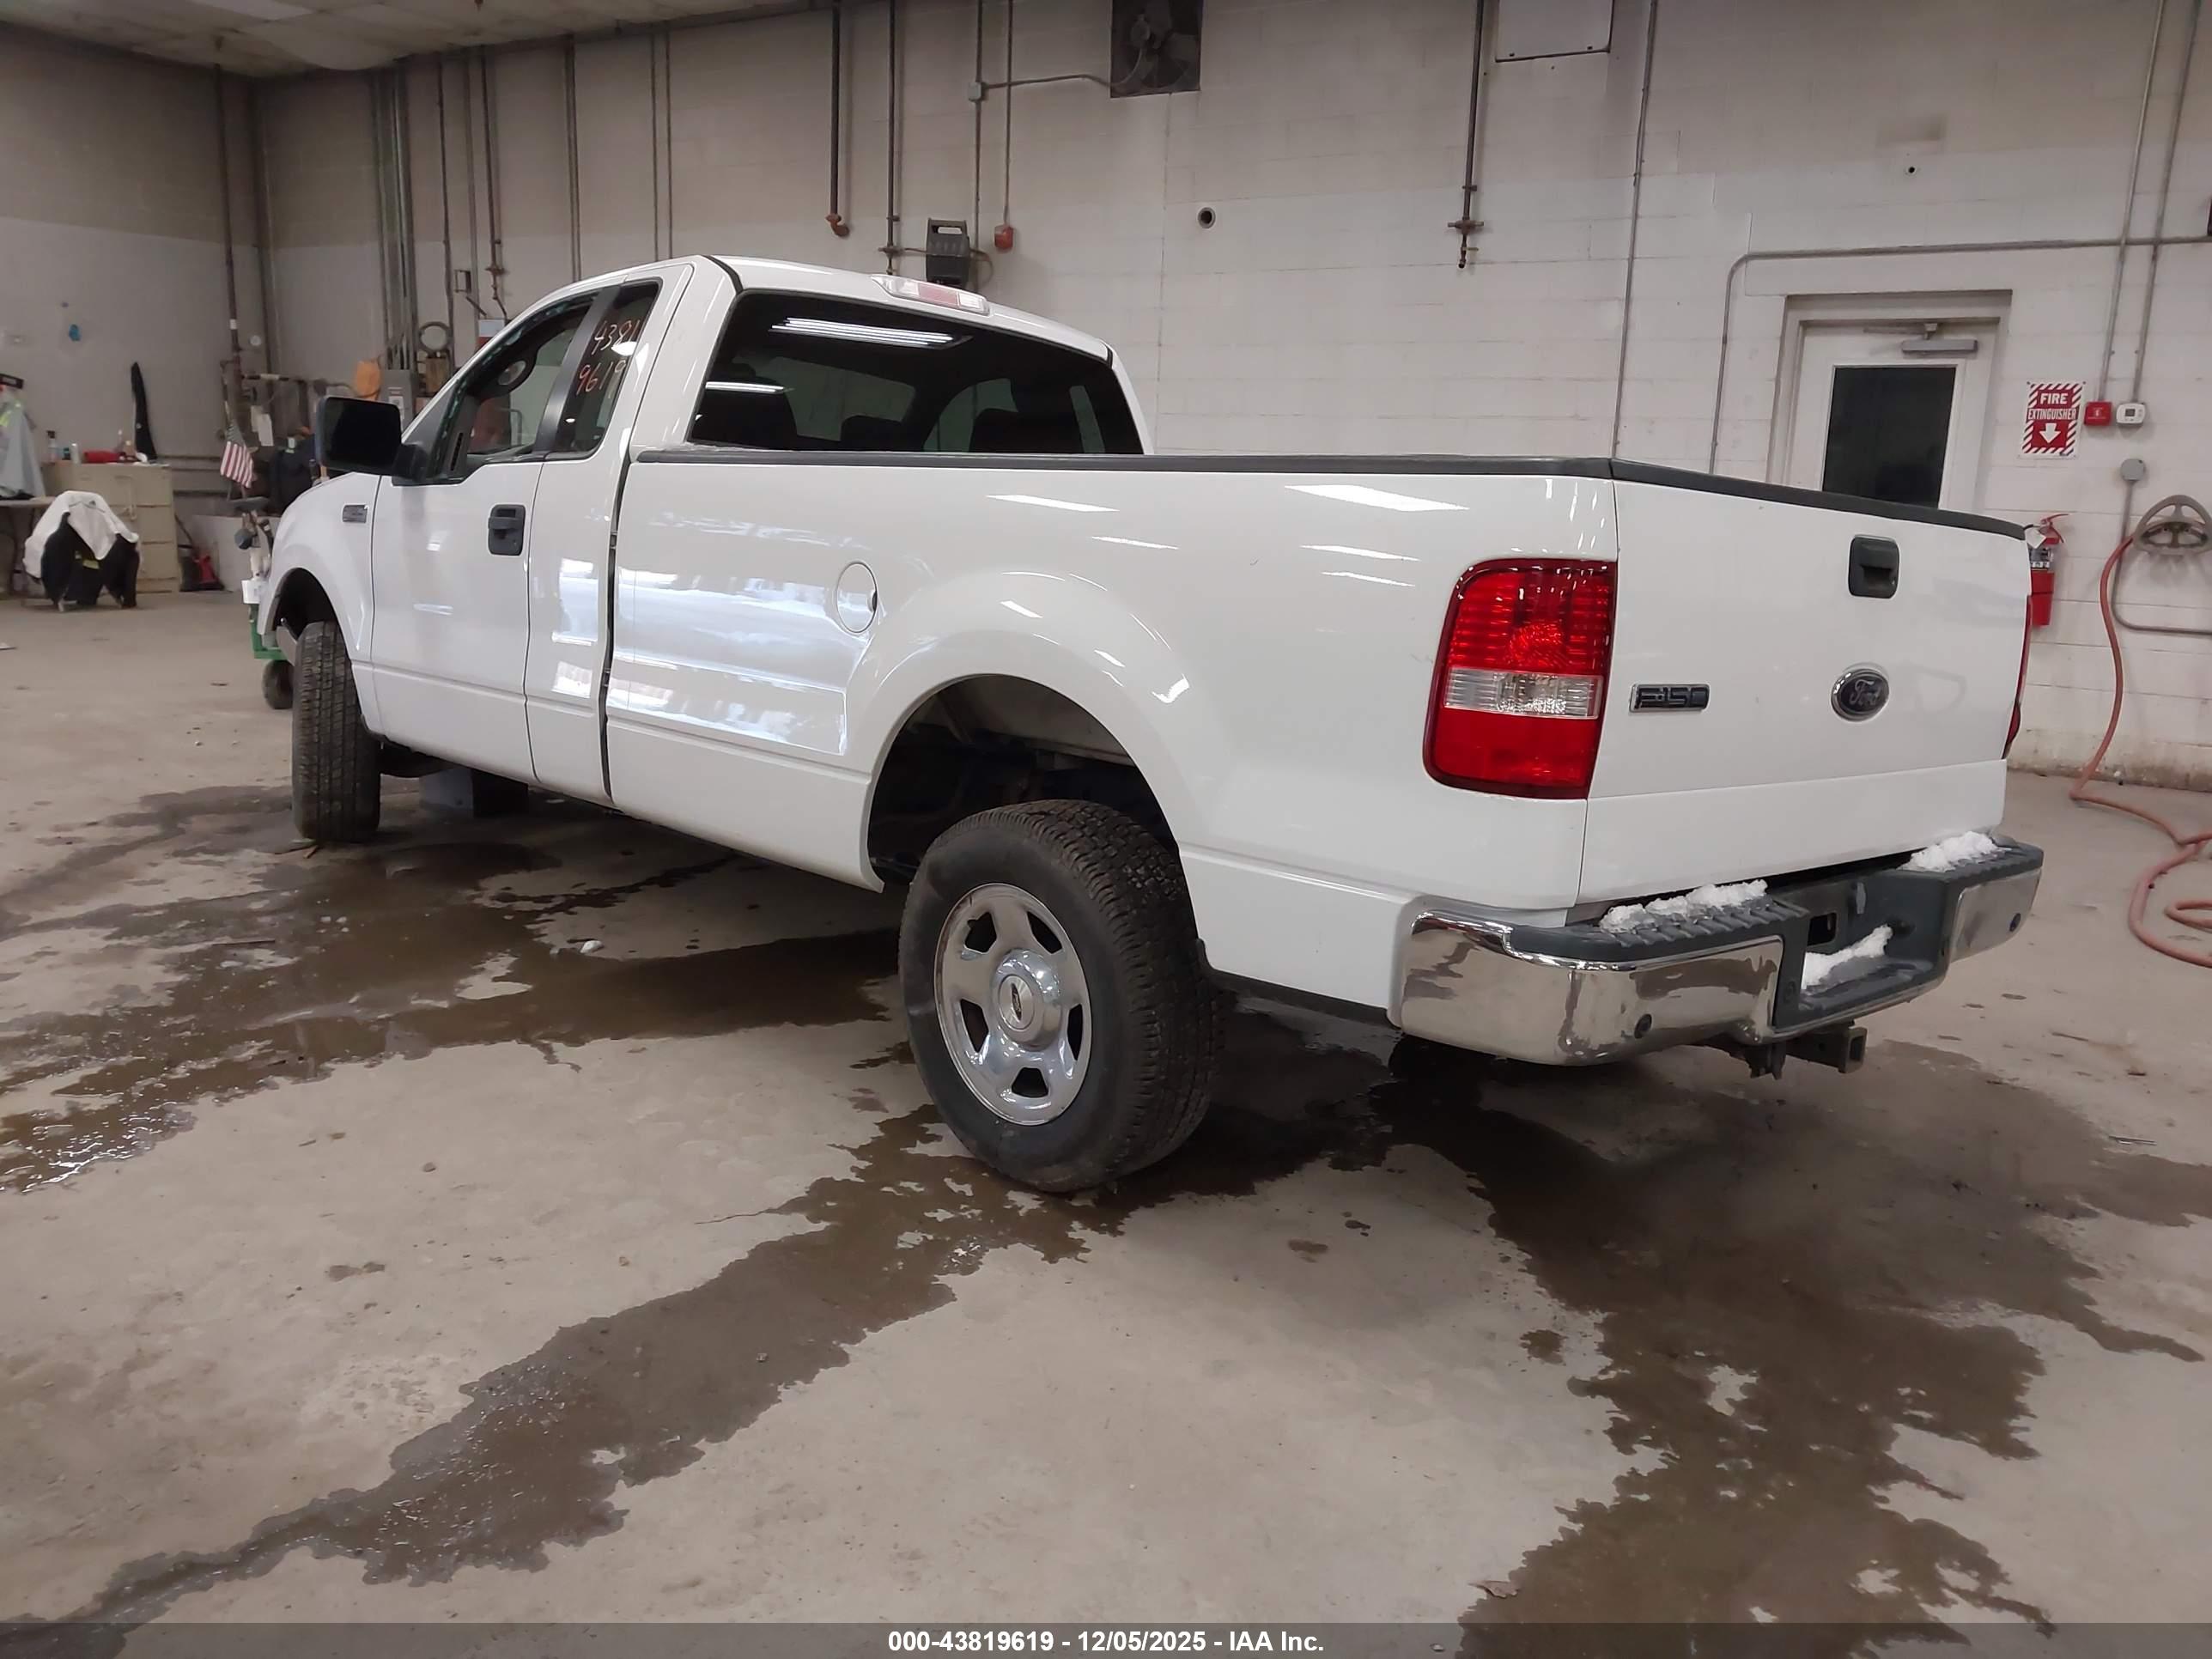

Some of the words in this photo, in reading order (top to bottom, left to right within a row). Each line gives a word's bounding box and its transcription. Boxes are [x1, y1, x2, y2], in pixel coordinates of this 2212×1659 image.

[575, 359, 627, 399] 9619
[2039, 392, 2069, 405] FIRE
[2027, 408, 2077, 420] EXTINGUISHER
